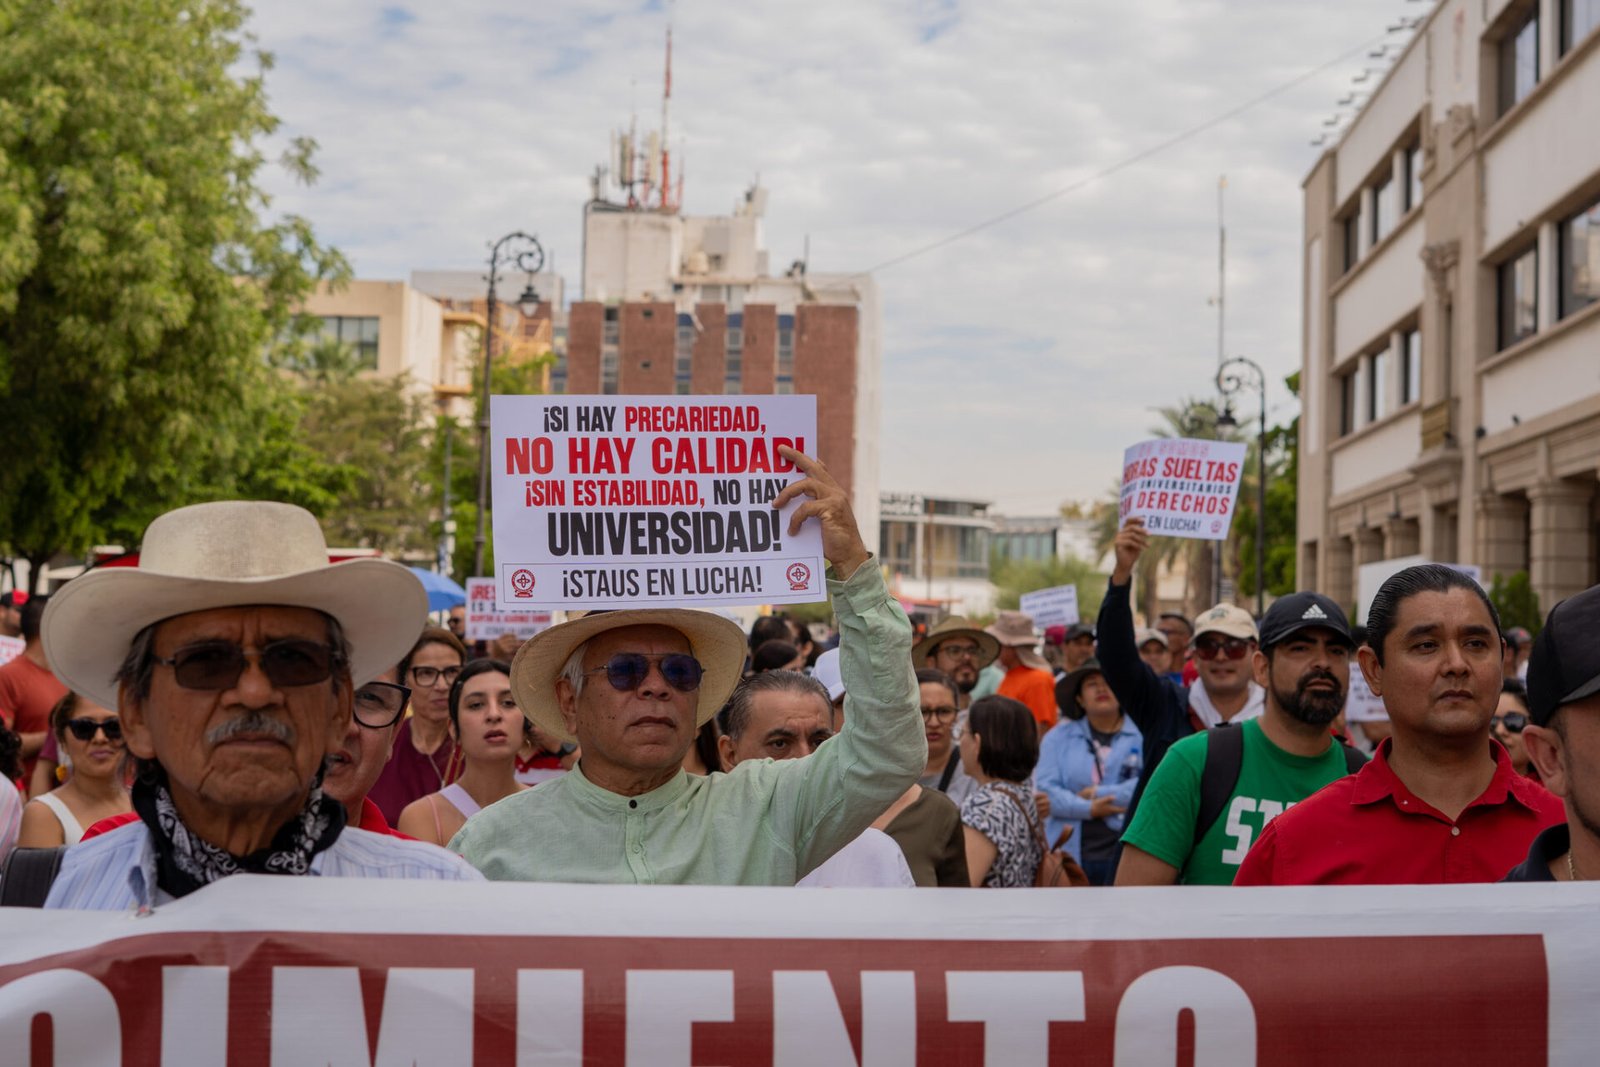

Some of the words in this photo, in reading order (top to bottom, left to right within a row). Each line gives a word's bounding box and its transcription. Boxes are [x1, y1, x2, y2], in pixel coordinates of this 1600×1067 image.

[544, 406, 568, 433] ¡SI
[577, 406, 616, 432] HAY
[625, 406, 766, 434] PRECARIEDAD,
[506, 437, 553, 474] NO
[569, 437, 635, 474] HAY
[1162, 457, 1238, 483] SUELTAS
[526, 480, 565, 506] ¡SIN
[573, 480, 705, 508] ESTABILIDAD,
[714, 479, 741, 505] NO
[749, 478, 787, 504] HAY
[1140, 479, 1232, 494] UNIVERSITARIOS
[1137, 491, 1230, 515] DERECHOS
[548, 509, 781, 556] UNIVERSIDAD!
[1148, 516, 1161, 528] EN
[563, 569, 640, 598] ¡STAUS
[647, 568, 675, 596] EN
[683, 566, 762, 595] LUCHA!
